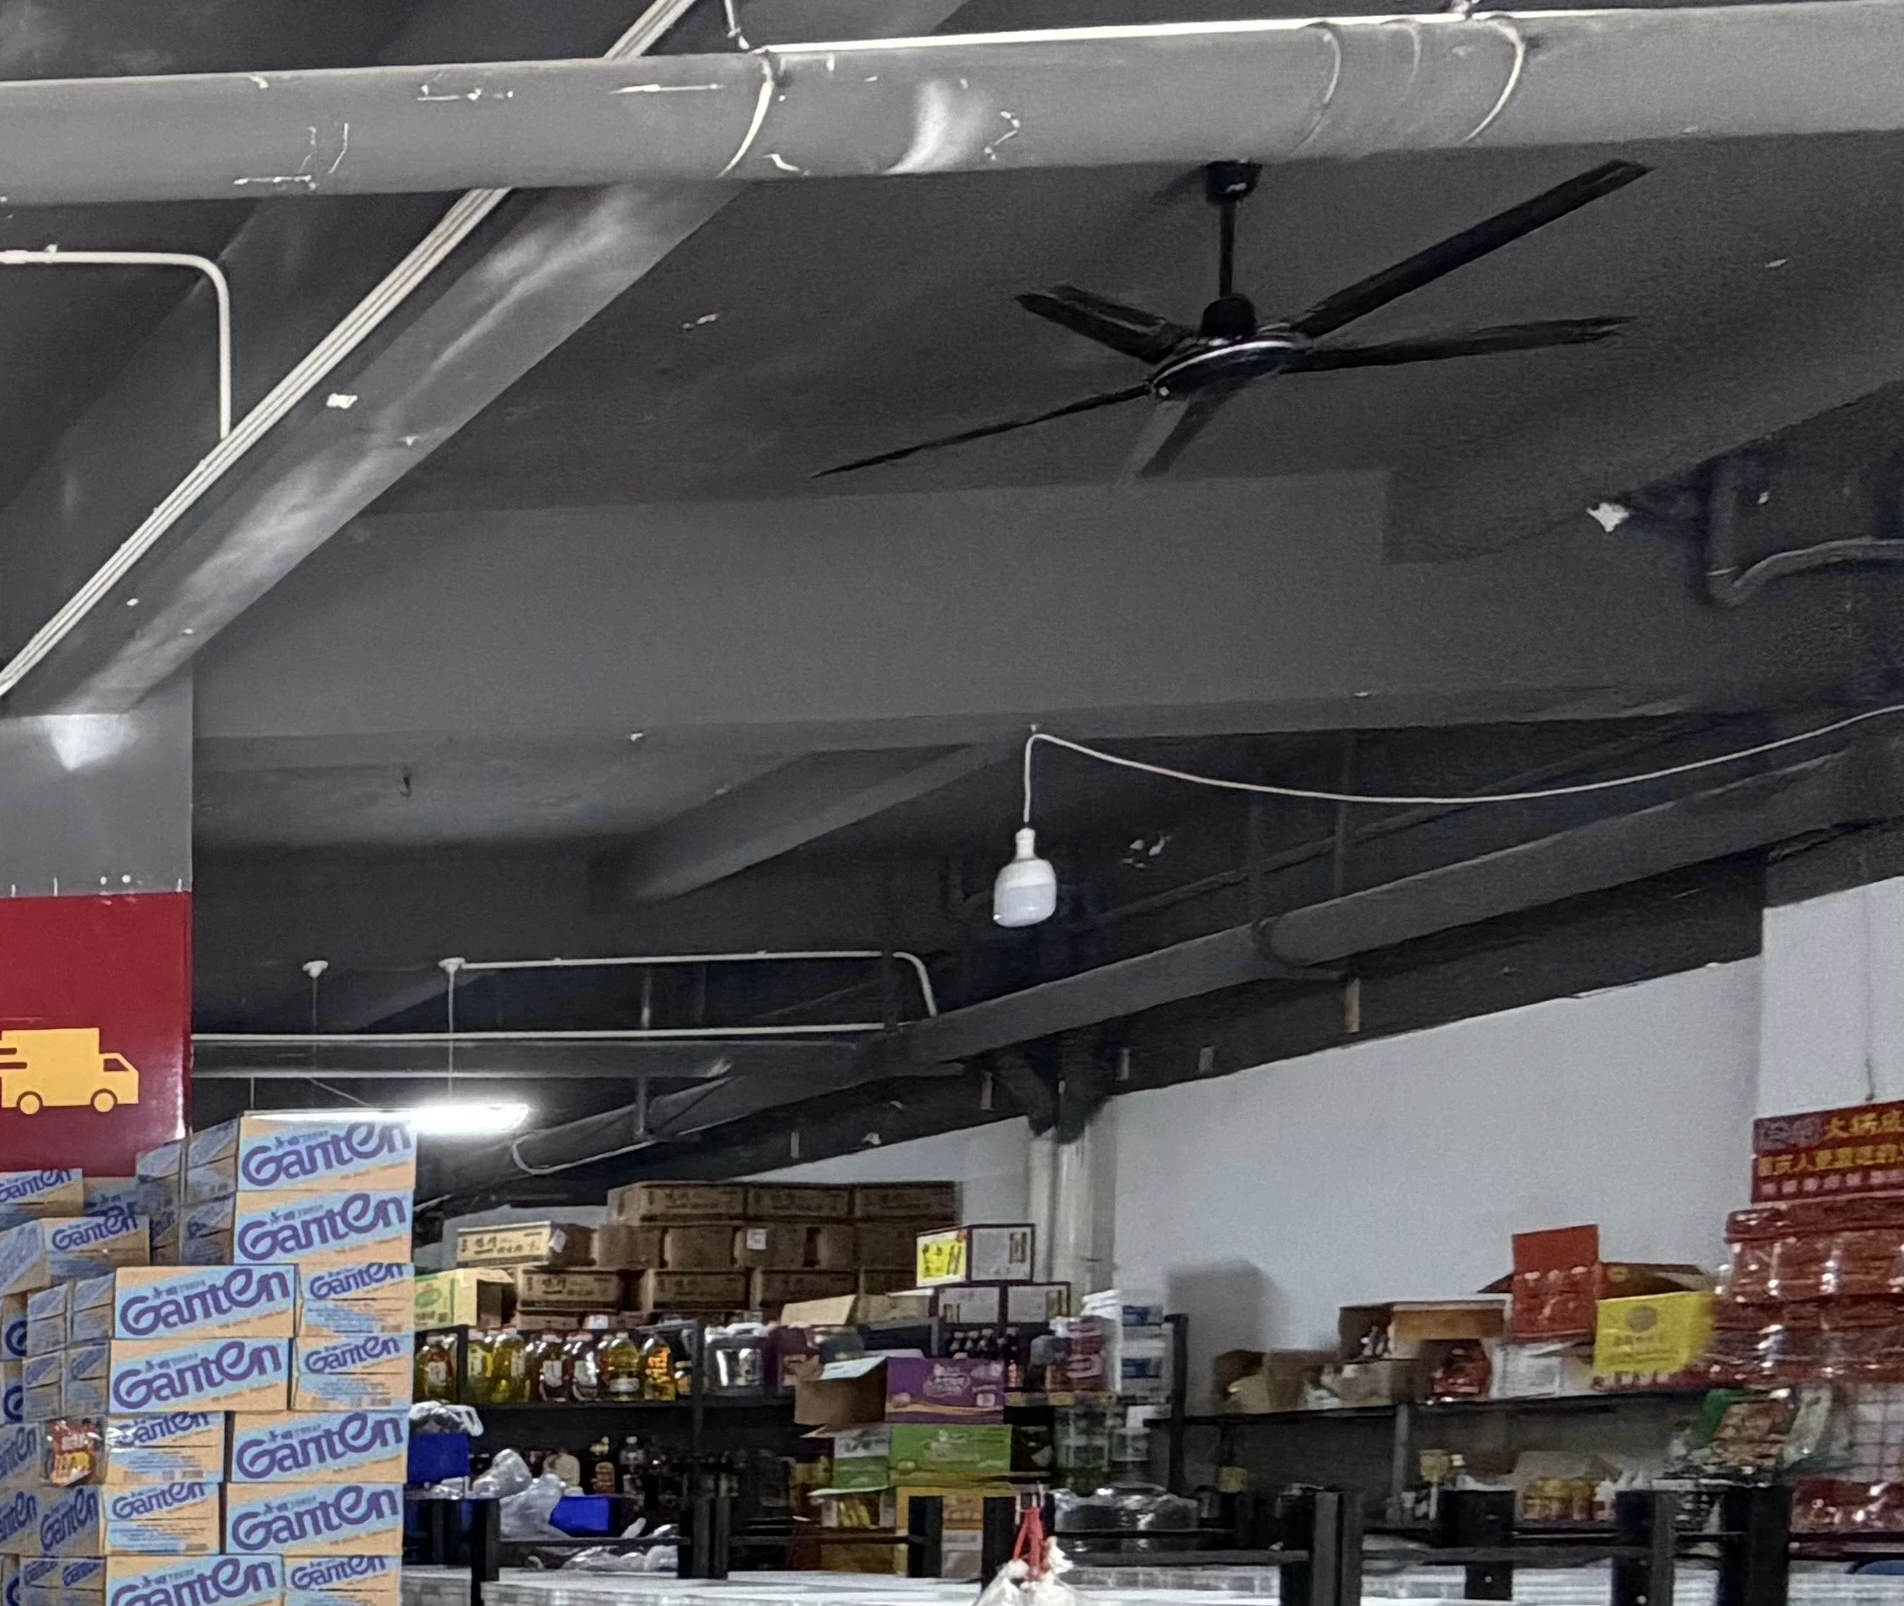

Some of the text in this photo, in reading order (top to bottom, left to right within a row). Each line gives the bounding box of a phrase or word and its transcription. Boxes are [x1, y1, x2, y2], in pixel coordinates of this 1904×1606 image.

[242, 1119, 411, 1186] Ganten
[52, 1213, 137, 1251] Ganten
[238, 1193, 407, 1261] Ganten
[119, 1268, 290, 1335] Ganten
[310, 1263, 403, 1300] Ganten
[113, 1340, 281, 1409] Ganten
[305, 1336, 399, 1374] Ganten
[237, 1412, 403, 1479] Ganten
[41, 1488, 100, 1551] Ganten
[113, 1482, 205, 1519] Ganten
[232, 1485, 399, 1550] Ganten
[291, 1555, 385, 1591] Ganten
